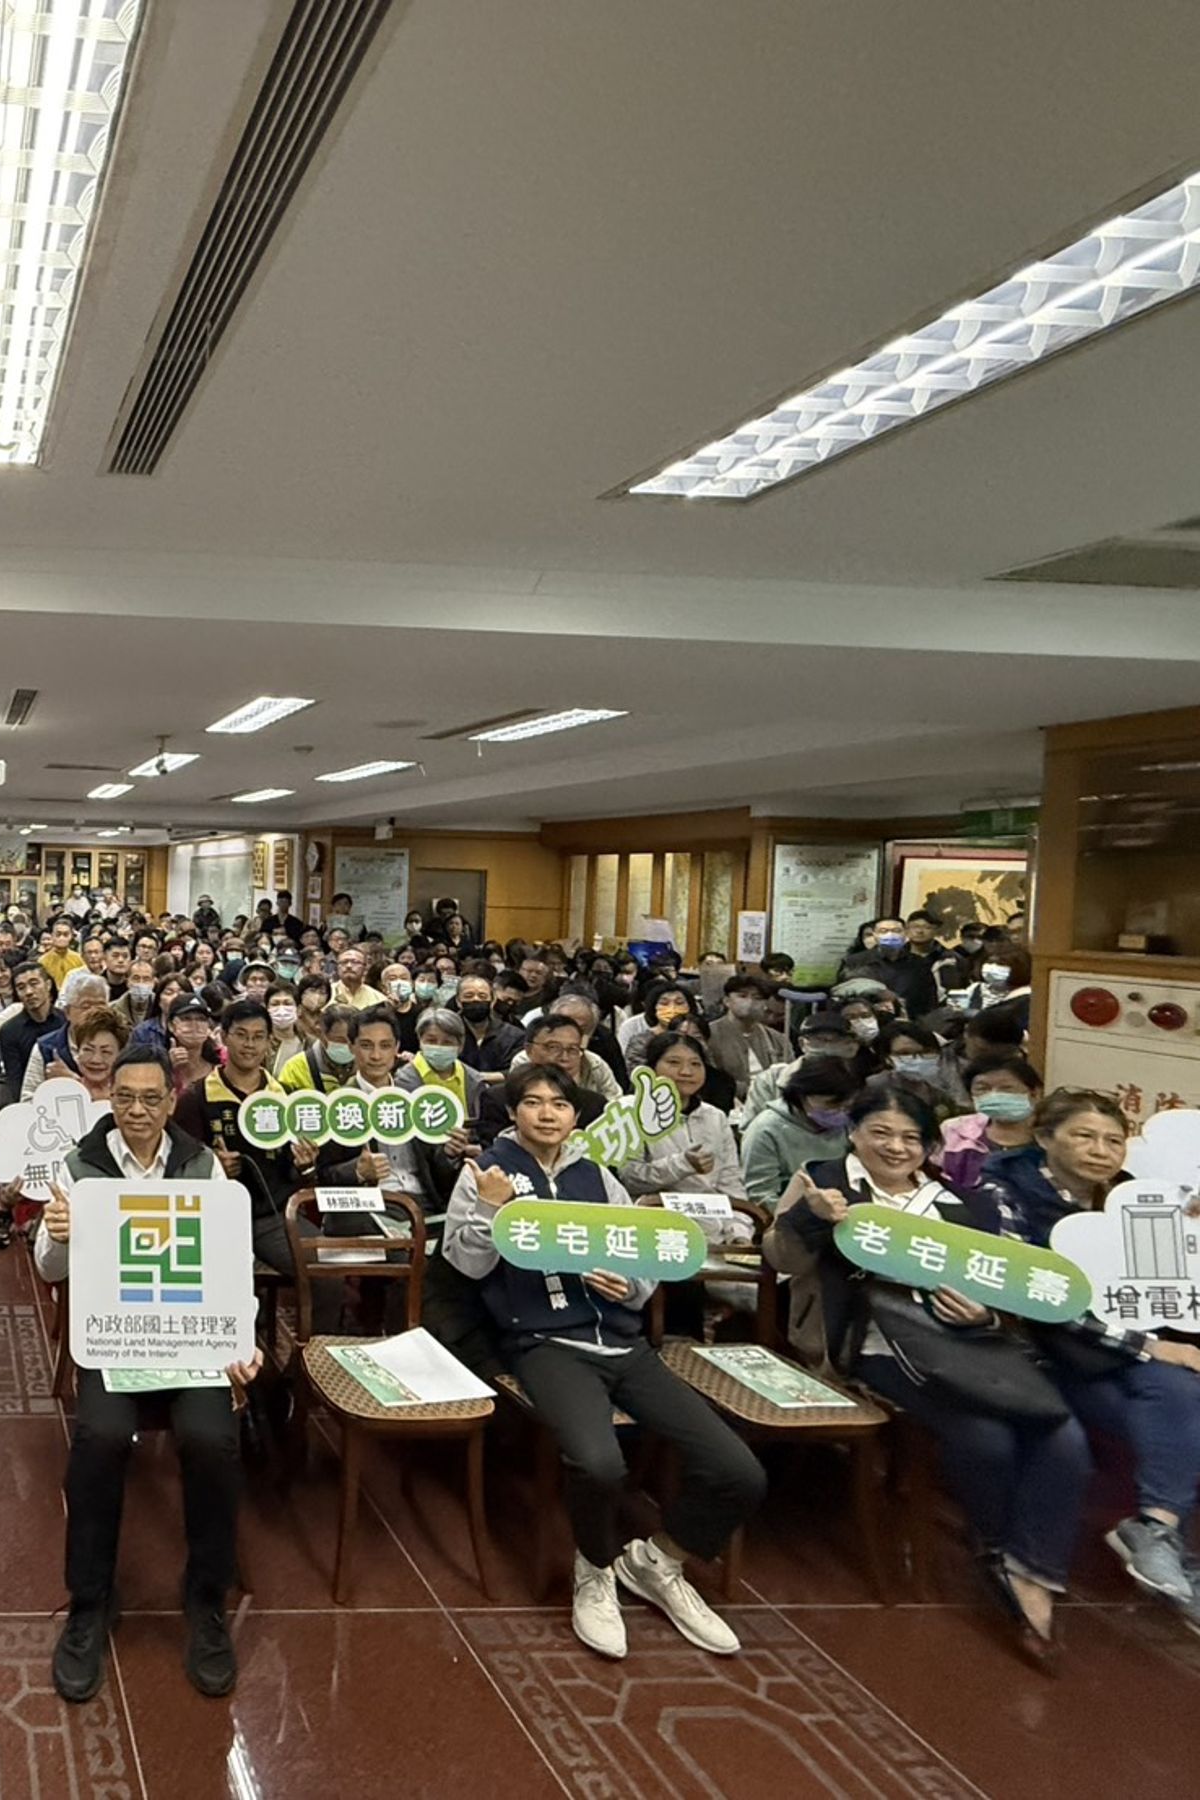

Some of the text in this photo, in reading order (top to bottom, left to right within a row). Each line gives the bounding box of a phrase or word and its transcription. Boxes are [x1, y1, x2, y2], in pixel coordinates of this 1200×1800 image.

[252, 1100, 448, 1133] 舊厝換新衫
[574, 1104, 640, 1161] 功
[24, 1161, 60, 1190] 無
[509, 1218, 689, 1263] 老宅延壽
[853, 1220, 1070, 1306] 老宅延壽
[86, 1314, 237, 1335] 內政部國土管理署
[86, 1337, 238, 1350] National Land Management Agency
[86, 1347, 178, 1359] Ministry of the Interior
